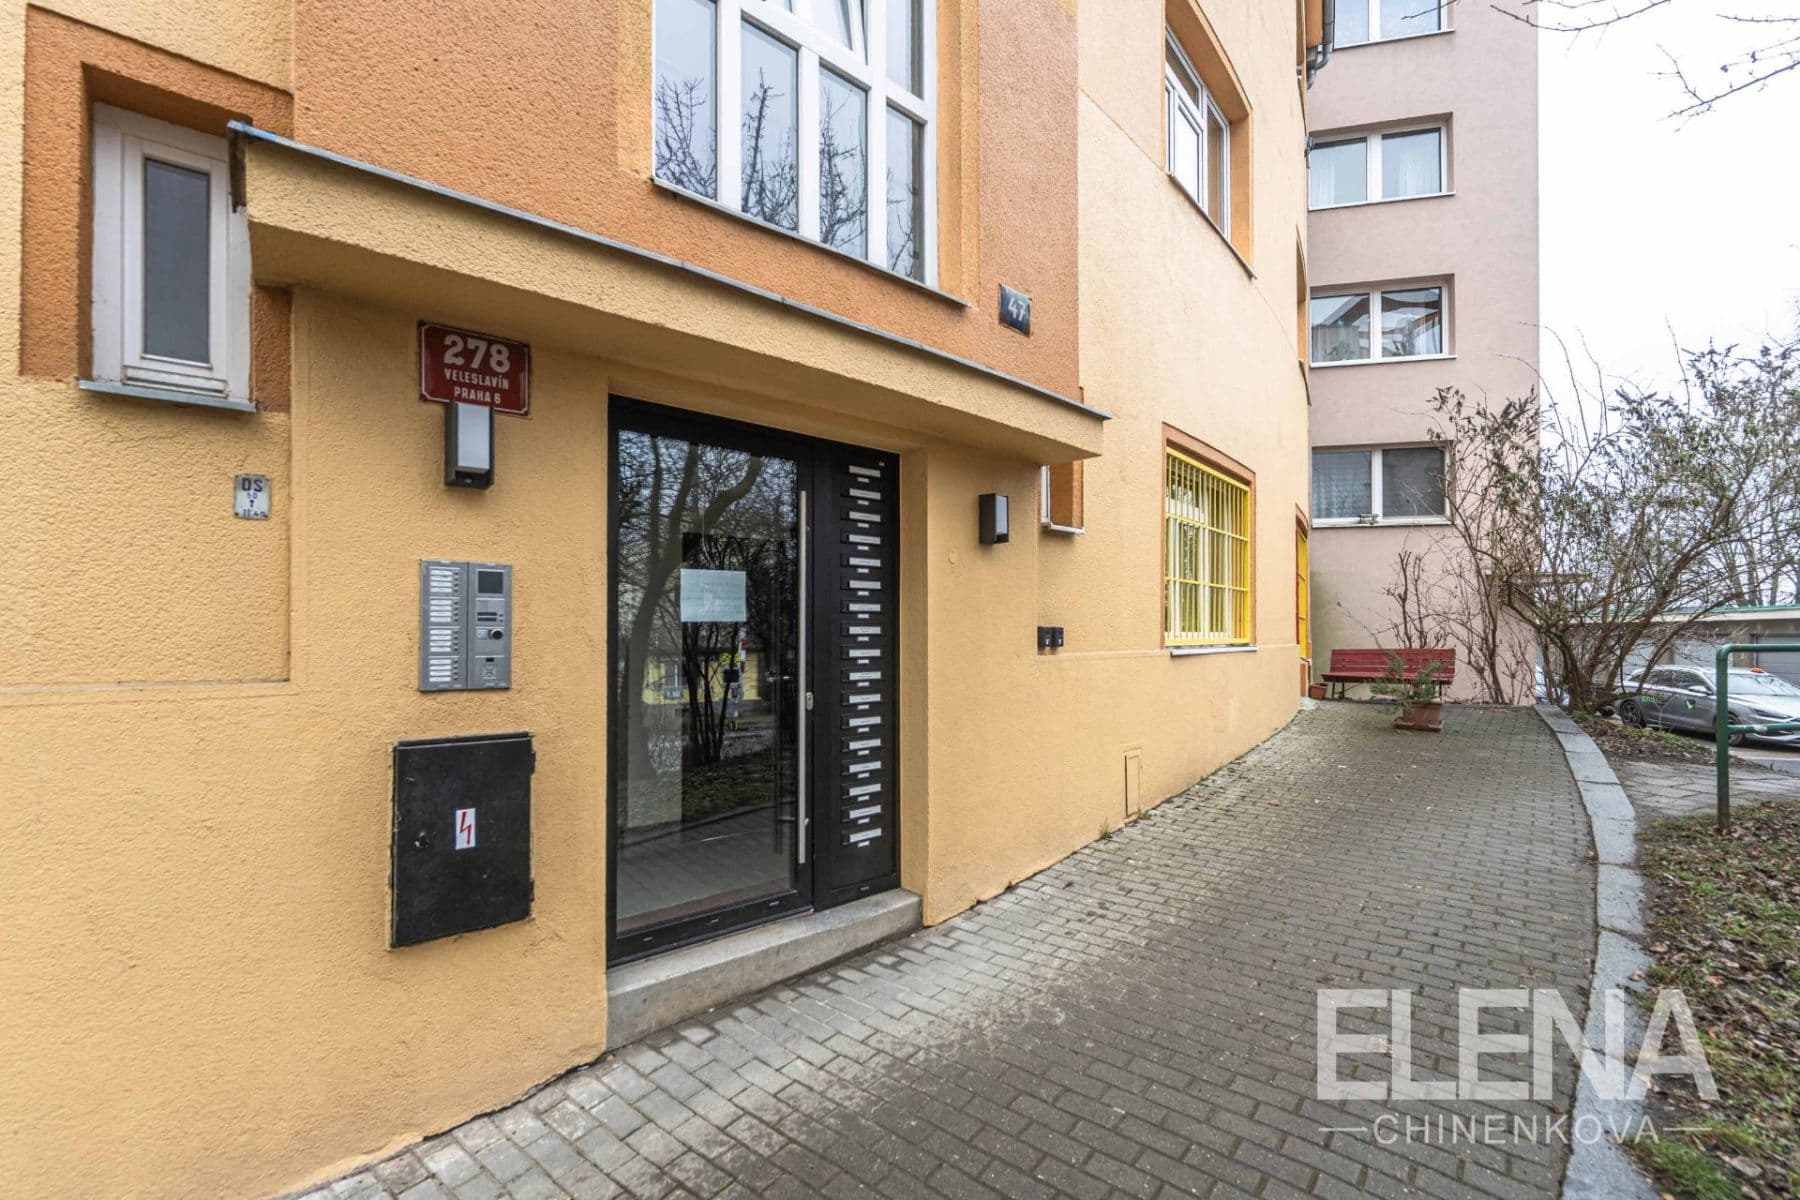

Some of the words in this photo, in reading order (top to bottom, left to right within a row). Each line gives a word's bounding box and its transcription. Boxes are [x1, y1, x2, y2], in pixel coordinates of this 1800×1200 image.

[1007, 298, 1026, 321] 47
[443, 334, 511, 373] 278
[444, 367, 509, 390] VELESLAVÍN
[454, 386, 491, 402] PRAHA
[494, 393, 501, 404] 6
[241, 477, 263, 492] OS
